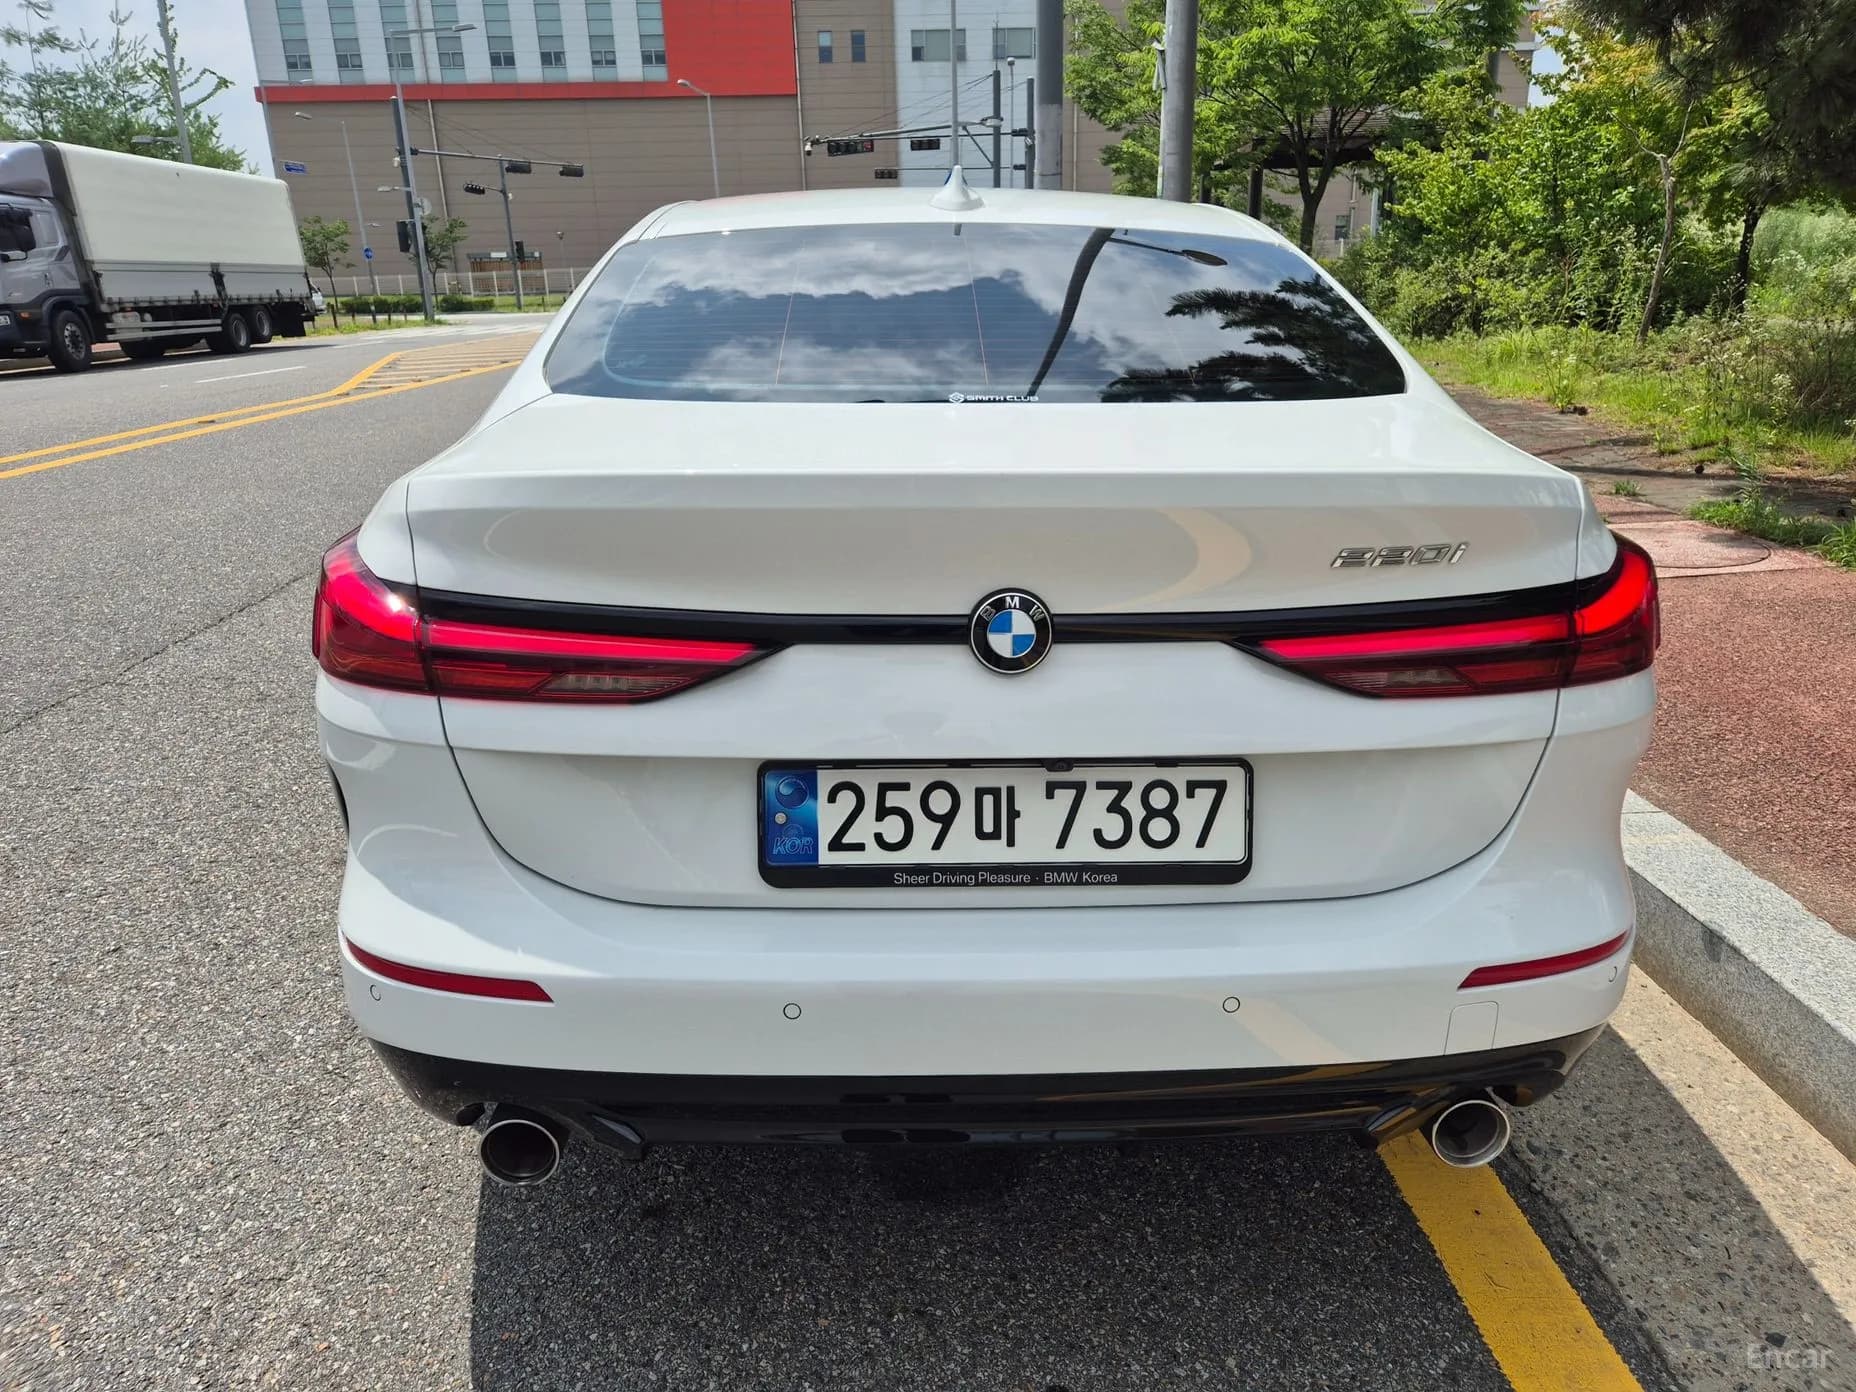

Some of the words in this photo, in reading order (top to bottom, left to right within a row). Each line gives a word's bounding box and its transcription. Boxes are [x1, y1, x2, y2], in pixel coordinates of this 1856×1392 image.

[1330, 541, 1470, 568] 220i
[980, 596, 1044, 622] BMW
[827, 780, 1021, 852] 259마
[1045, 779, 1228, 850] 7387
[773, 836, 814, 855] KOR
[893, 872, 930, 885] Sheer
[932, 872, 976, 886] Driving
[978, 871, 1031, 885] Pleasure
[1043, 872, 1079, 883] BMW
[1082, 871, 1118, 883] Korea
